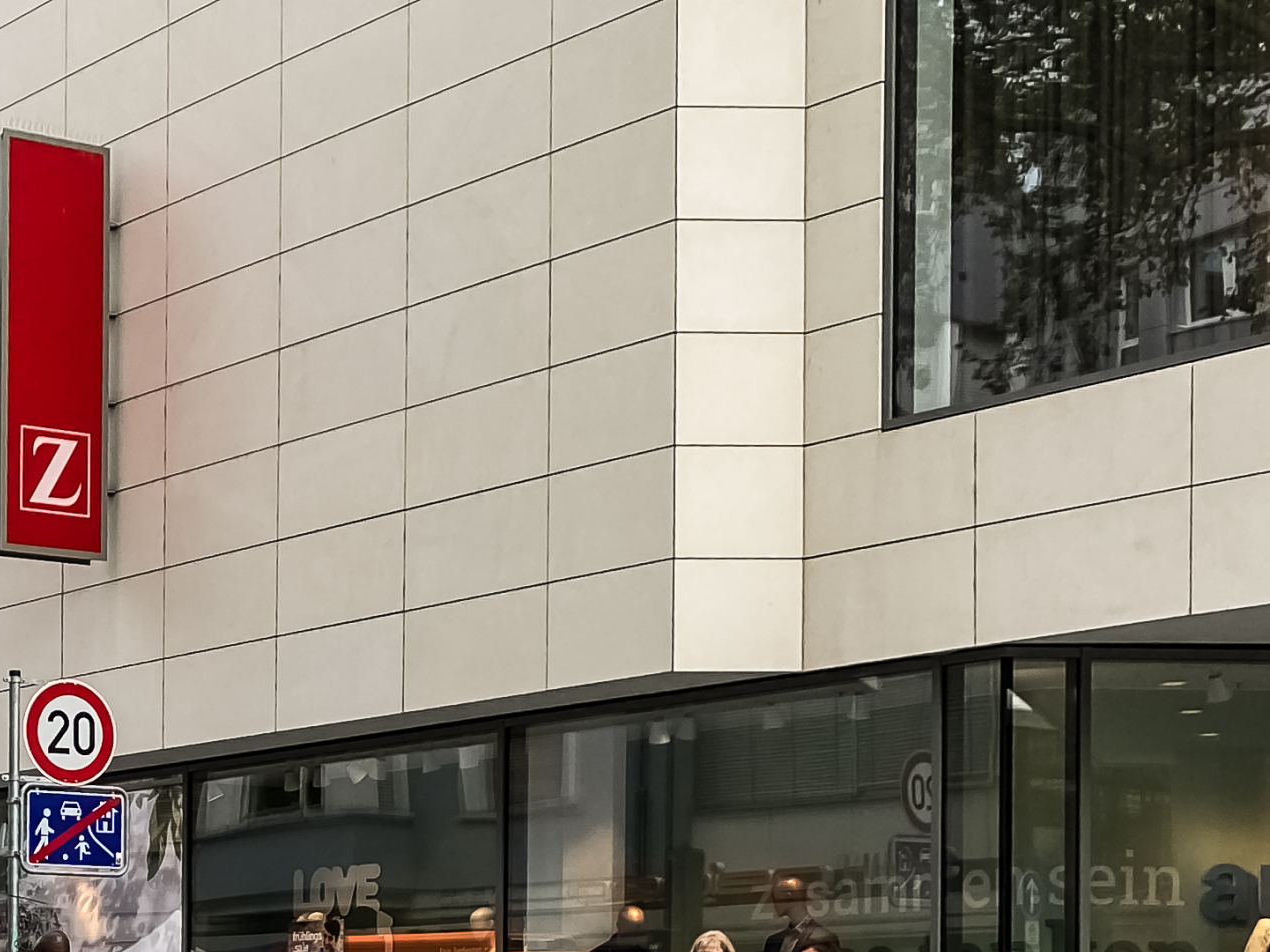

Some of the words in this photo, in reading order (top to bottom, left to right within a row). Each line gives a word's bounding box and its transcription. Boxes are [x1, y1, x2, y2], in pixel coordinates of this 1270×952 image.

[29, 434, 83, 508] Z
[47, 709, 96, 756] 20
[292, 862, 382, 918] LOVE
